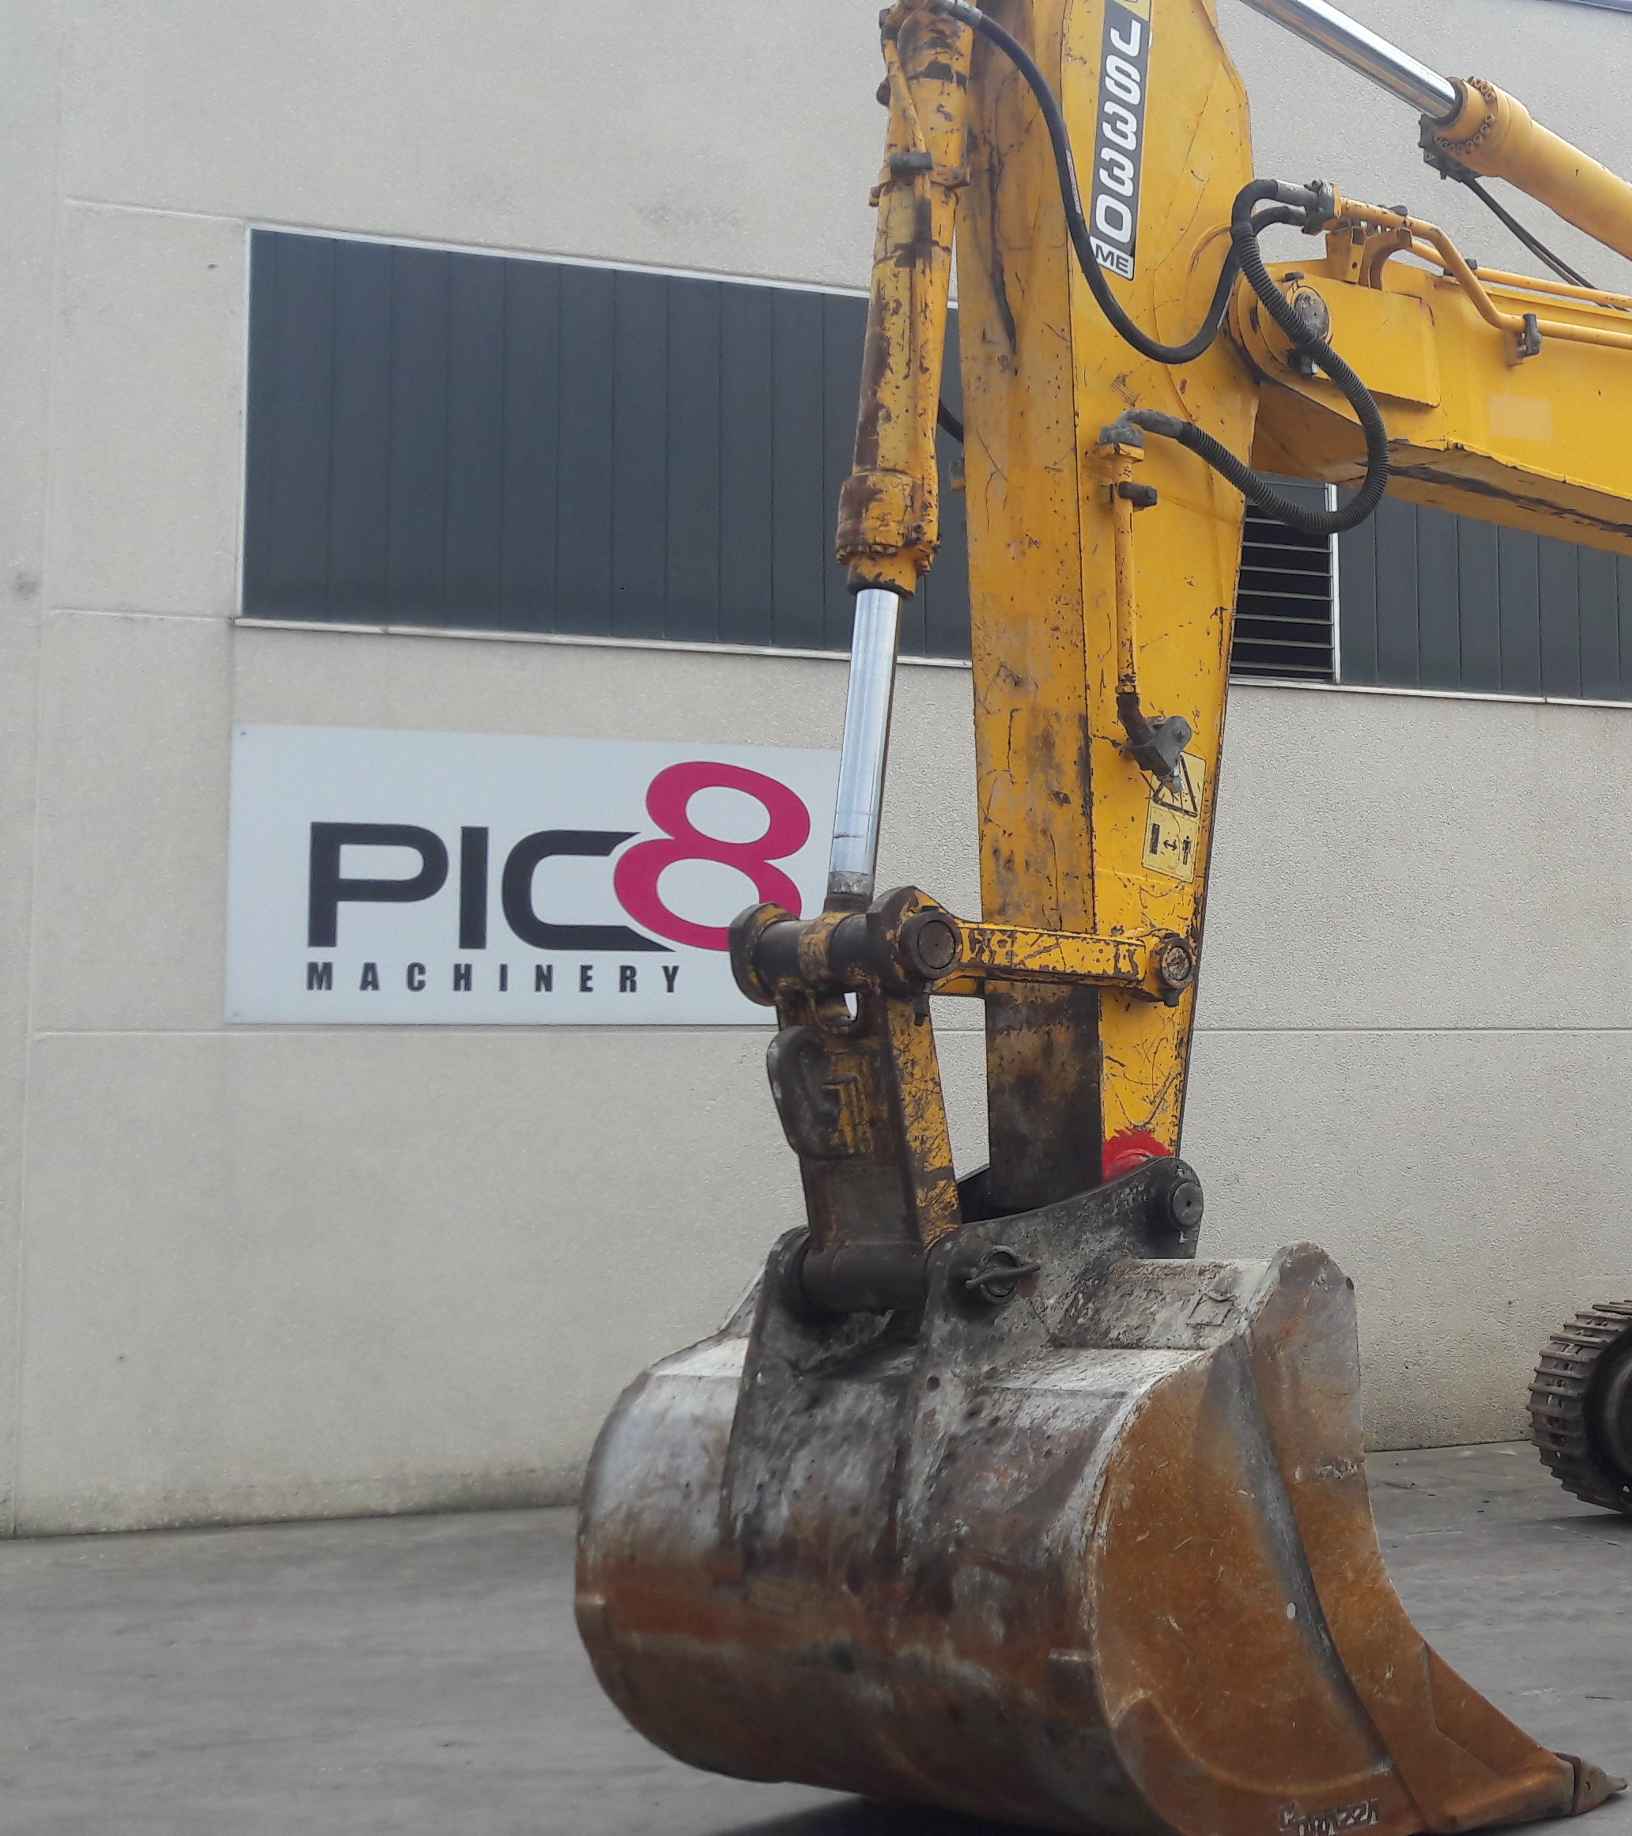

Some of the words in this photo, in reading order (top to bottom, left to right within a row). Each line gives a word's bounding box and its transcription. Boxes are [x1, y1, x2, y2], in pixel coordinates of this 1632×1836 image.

[1095, 19, 1142, 244] JS330
[1095, 246, 1131, 271] ME
[307, 761, 811, 953] PIC8
[306, 961, 681, 993] MACHINERY
